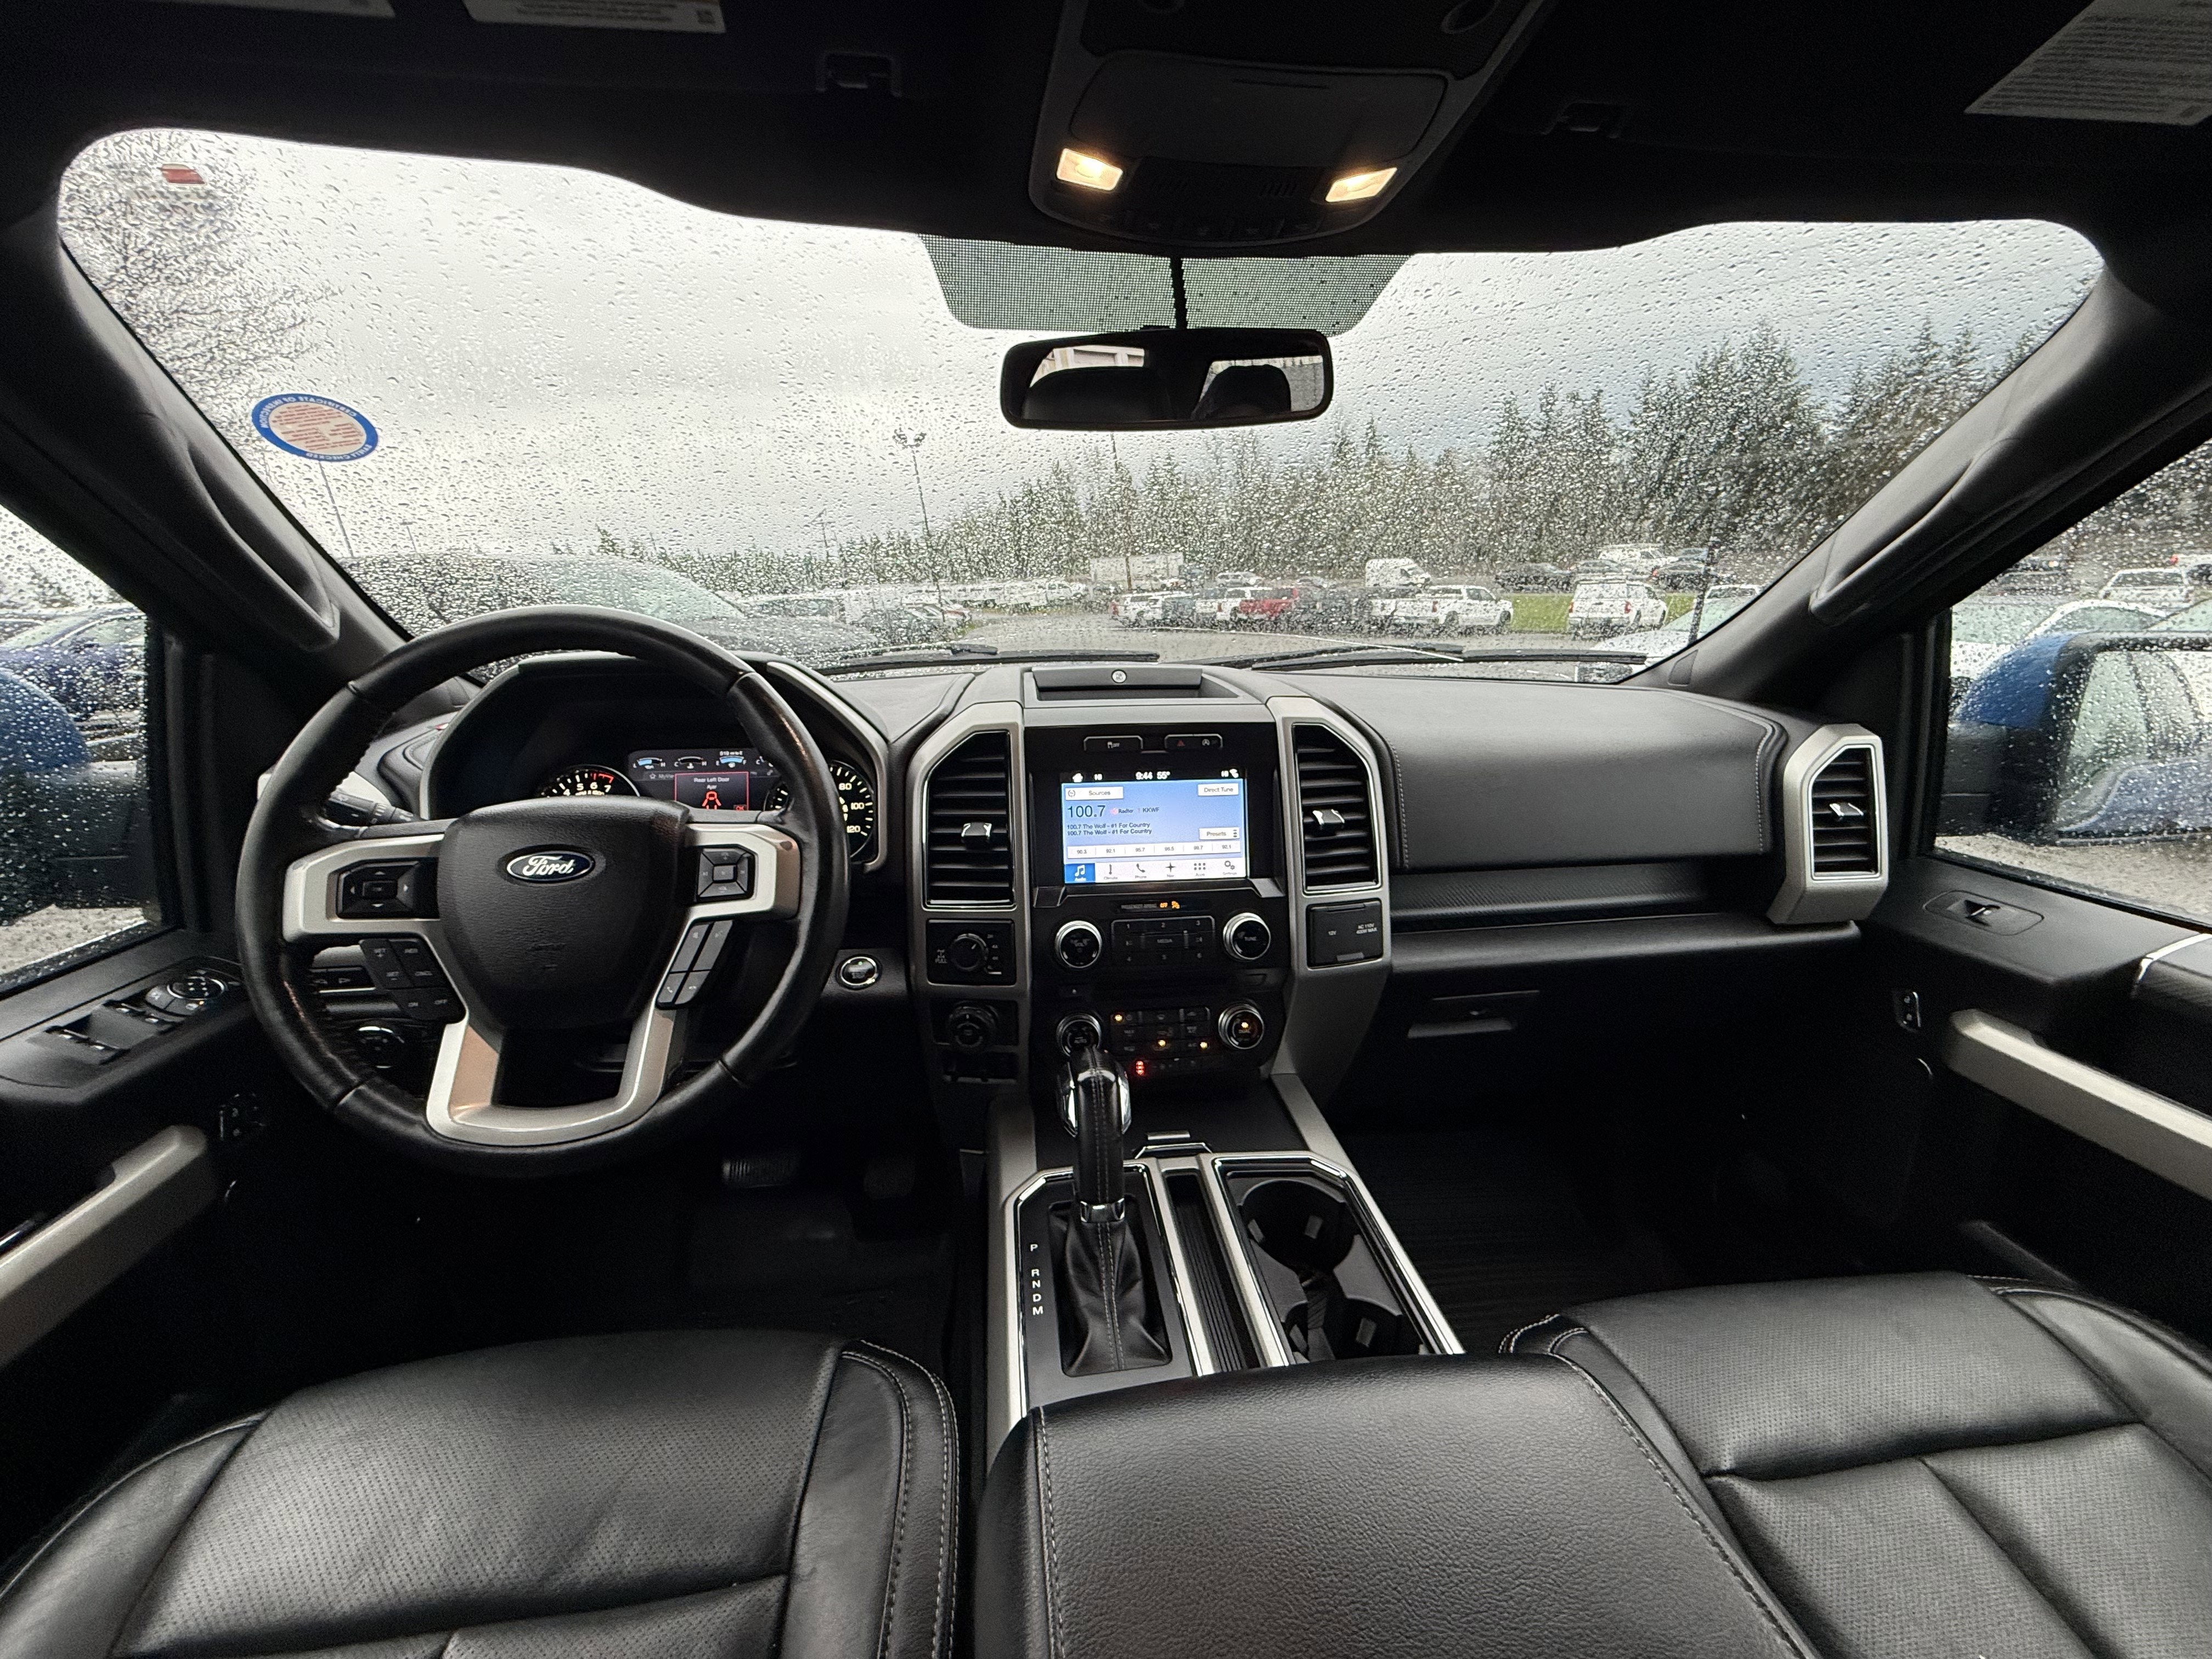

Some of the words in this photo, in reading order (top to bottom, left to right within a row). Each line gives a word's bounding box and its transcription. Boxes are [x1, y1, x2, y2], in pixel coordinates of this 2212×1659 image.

[1135, 771, 1153, 780] 9:44
[838, 782, 853, 791] 80
[850, 802, 865, 810] 100
[1067, 805, 1106, 818] 100.7
[847, 825, 861, 833] 120
[522, 855, 575, 876] Ford
[1030, 1243, 1039, 1252] P
[1031, 1269, 1040, 1277] R
[1032, 1279, 1041, 1289] N
[1032, 1293, 1042, 1302] D
[1032, 1306, 1043, 1316] M
